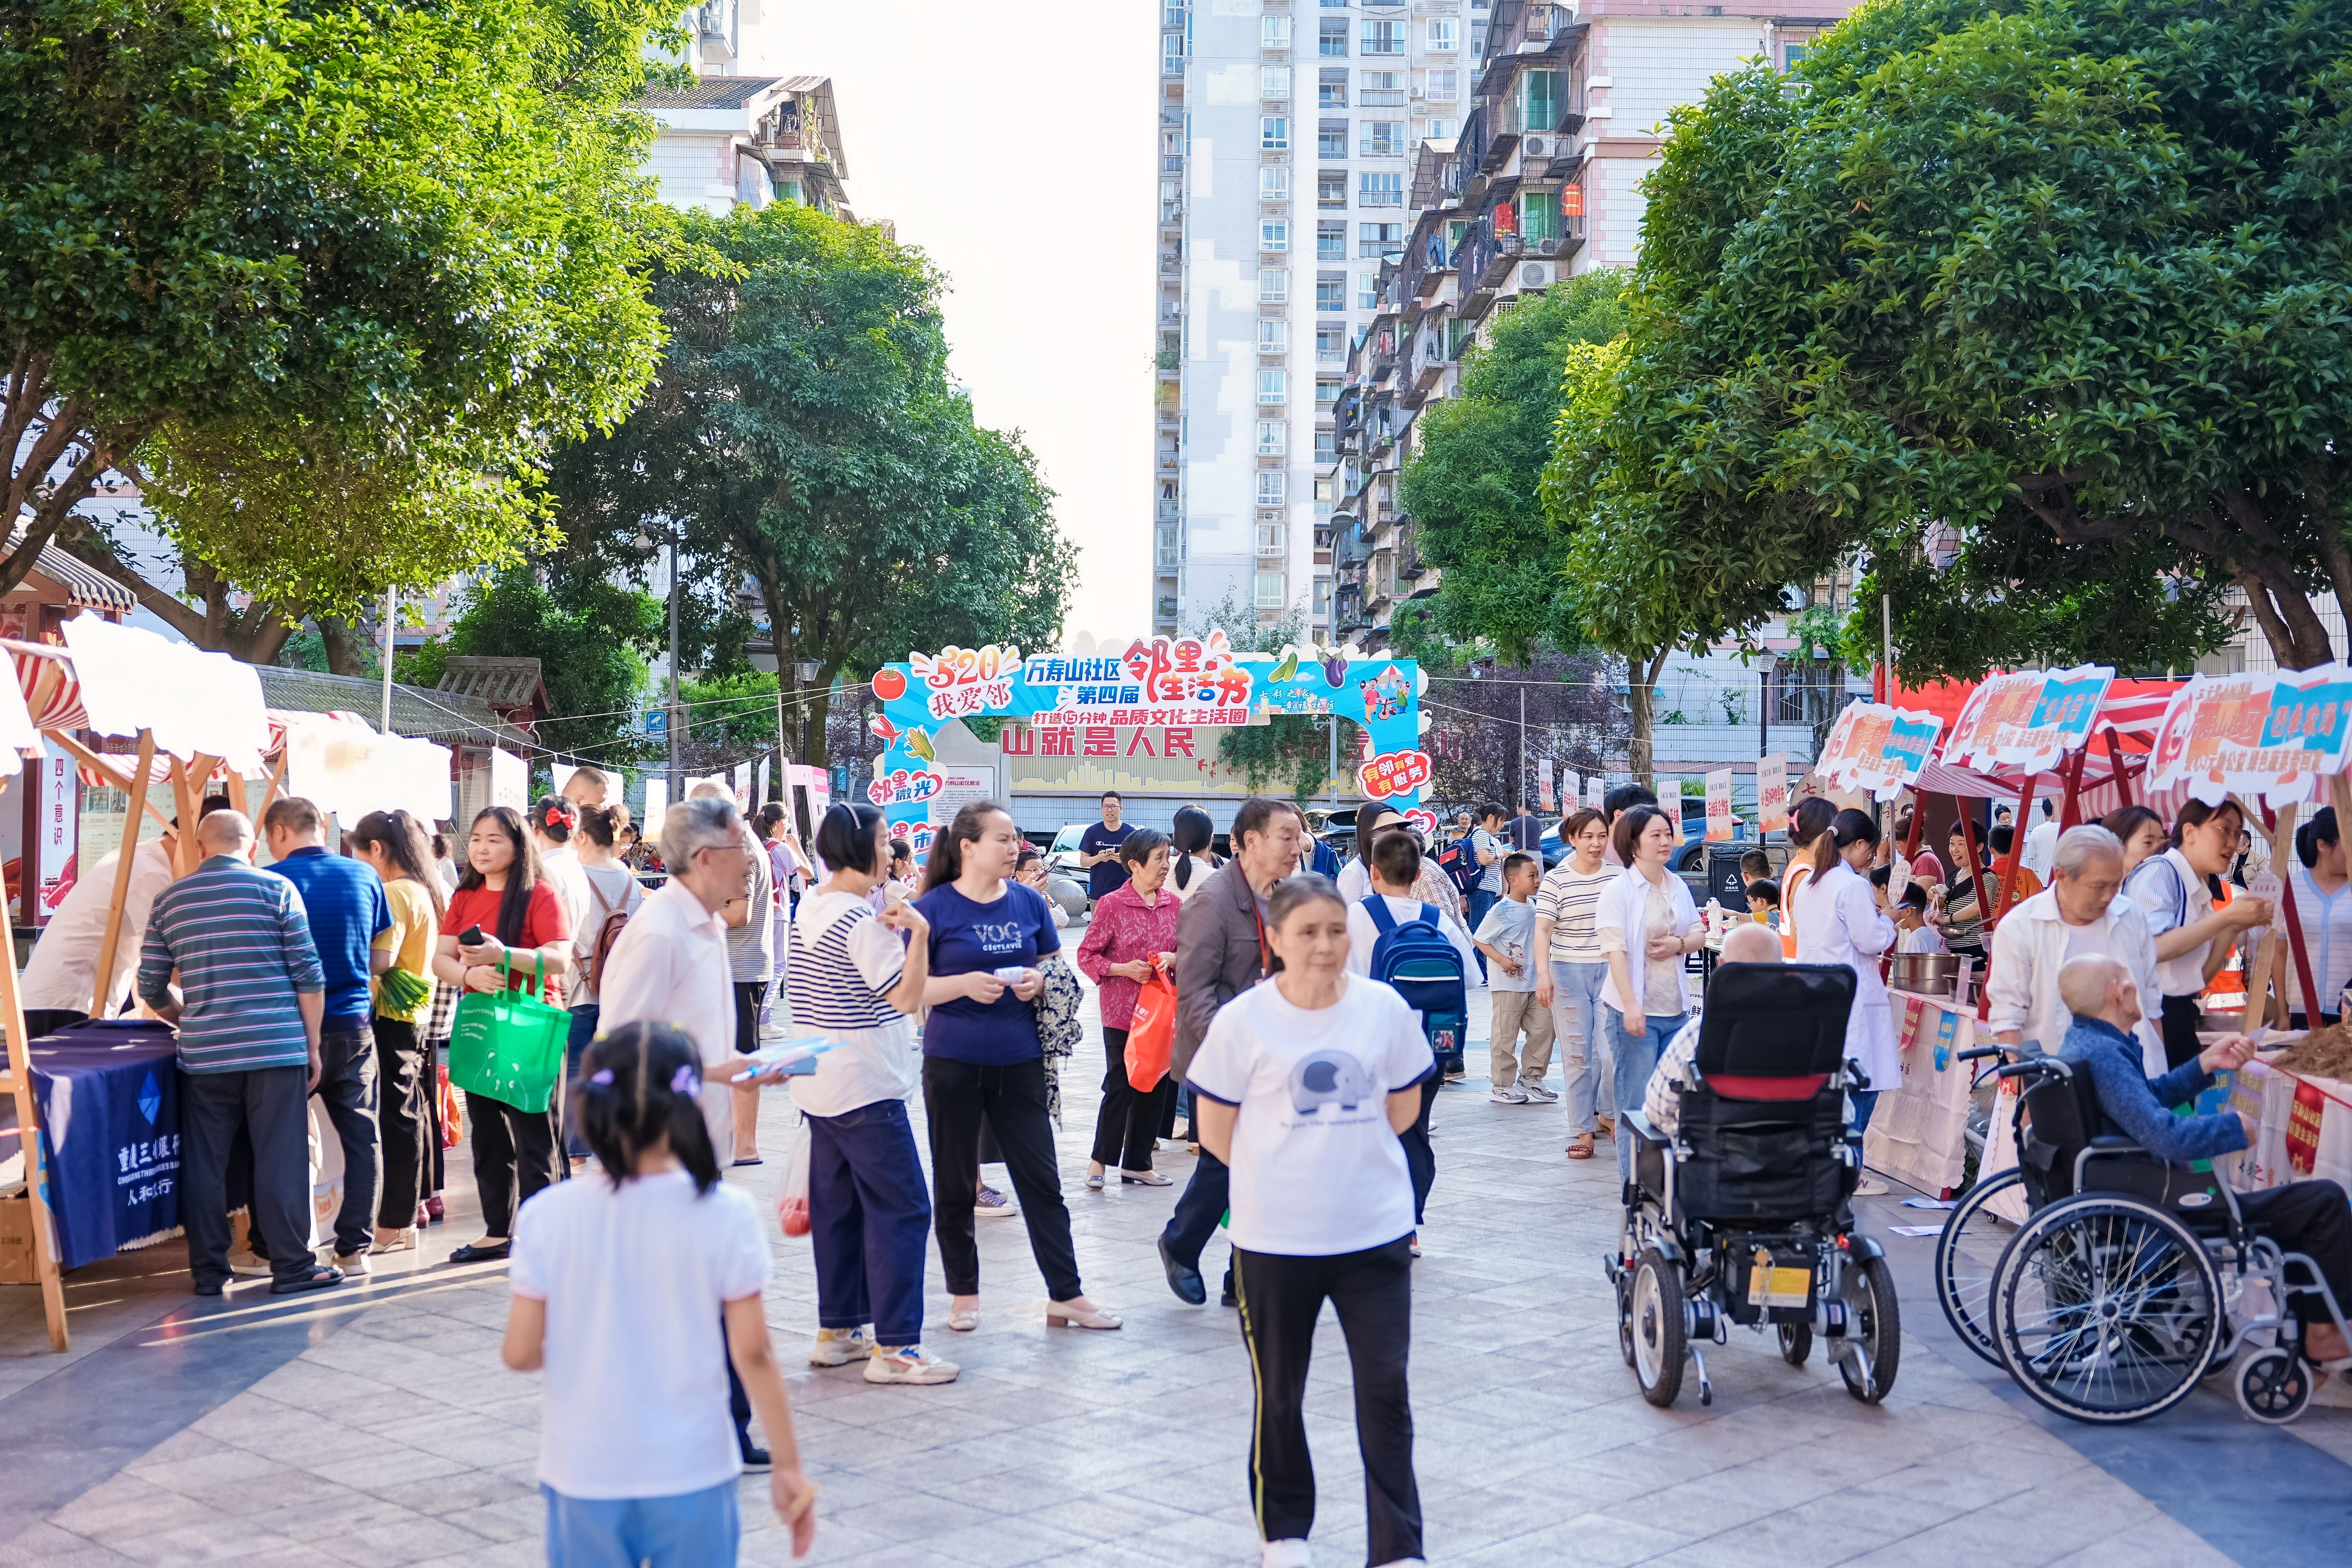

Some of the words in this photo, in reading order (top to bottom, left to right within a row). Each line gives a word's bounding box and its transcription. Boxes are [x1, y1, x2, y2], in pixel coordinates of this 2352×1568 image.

[929, 648, 999, 688] 520
[1027, 658, 1121, 682] 万寿山社区
[1122, 639, 1202, 704] 邻里
[1076, 685, 1139, 705] 第四届
[1159, 667, 1249, 706] 生活节
[1259, 689, 1310, 699] 七彩之家
[1110, 708, 1247, 725] 品质文化生活圈
[1284, 700, 1335, 712] 幸福社区
[1002, 724, 1195, 758] 山就是人民
[1363, 755, 1416, 783] 有邻有爱
[1378, 765, 1423, 793] 有服务
[54, 758, 63, 846] 四个意识
[2293, 1099, 2322, 1129] 万寿山社区
